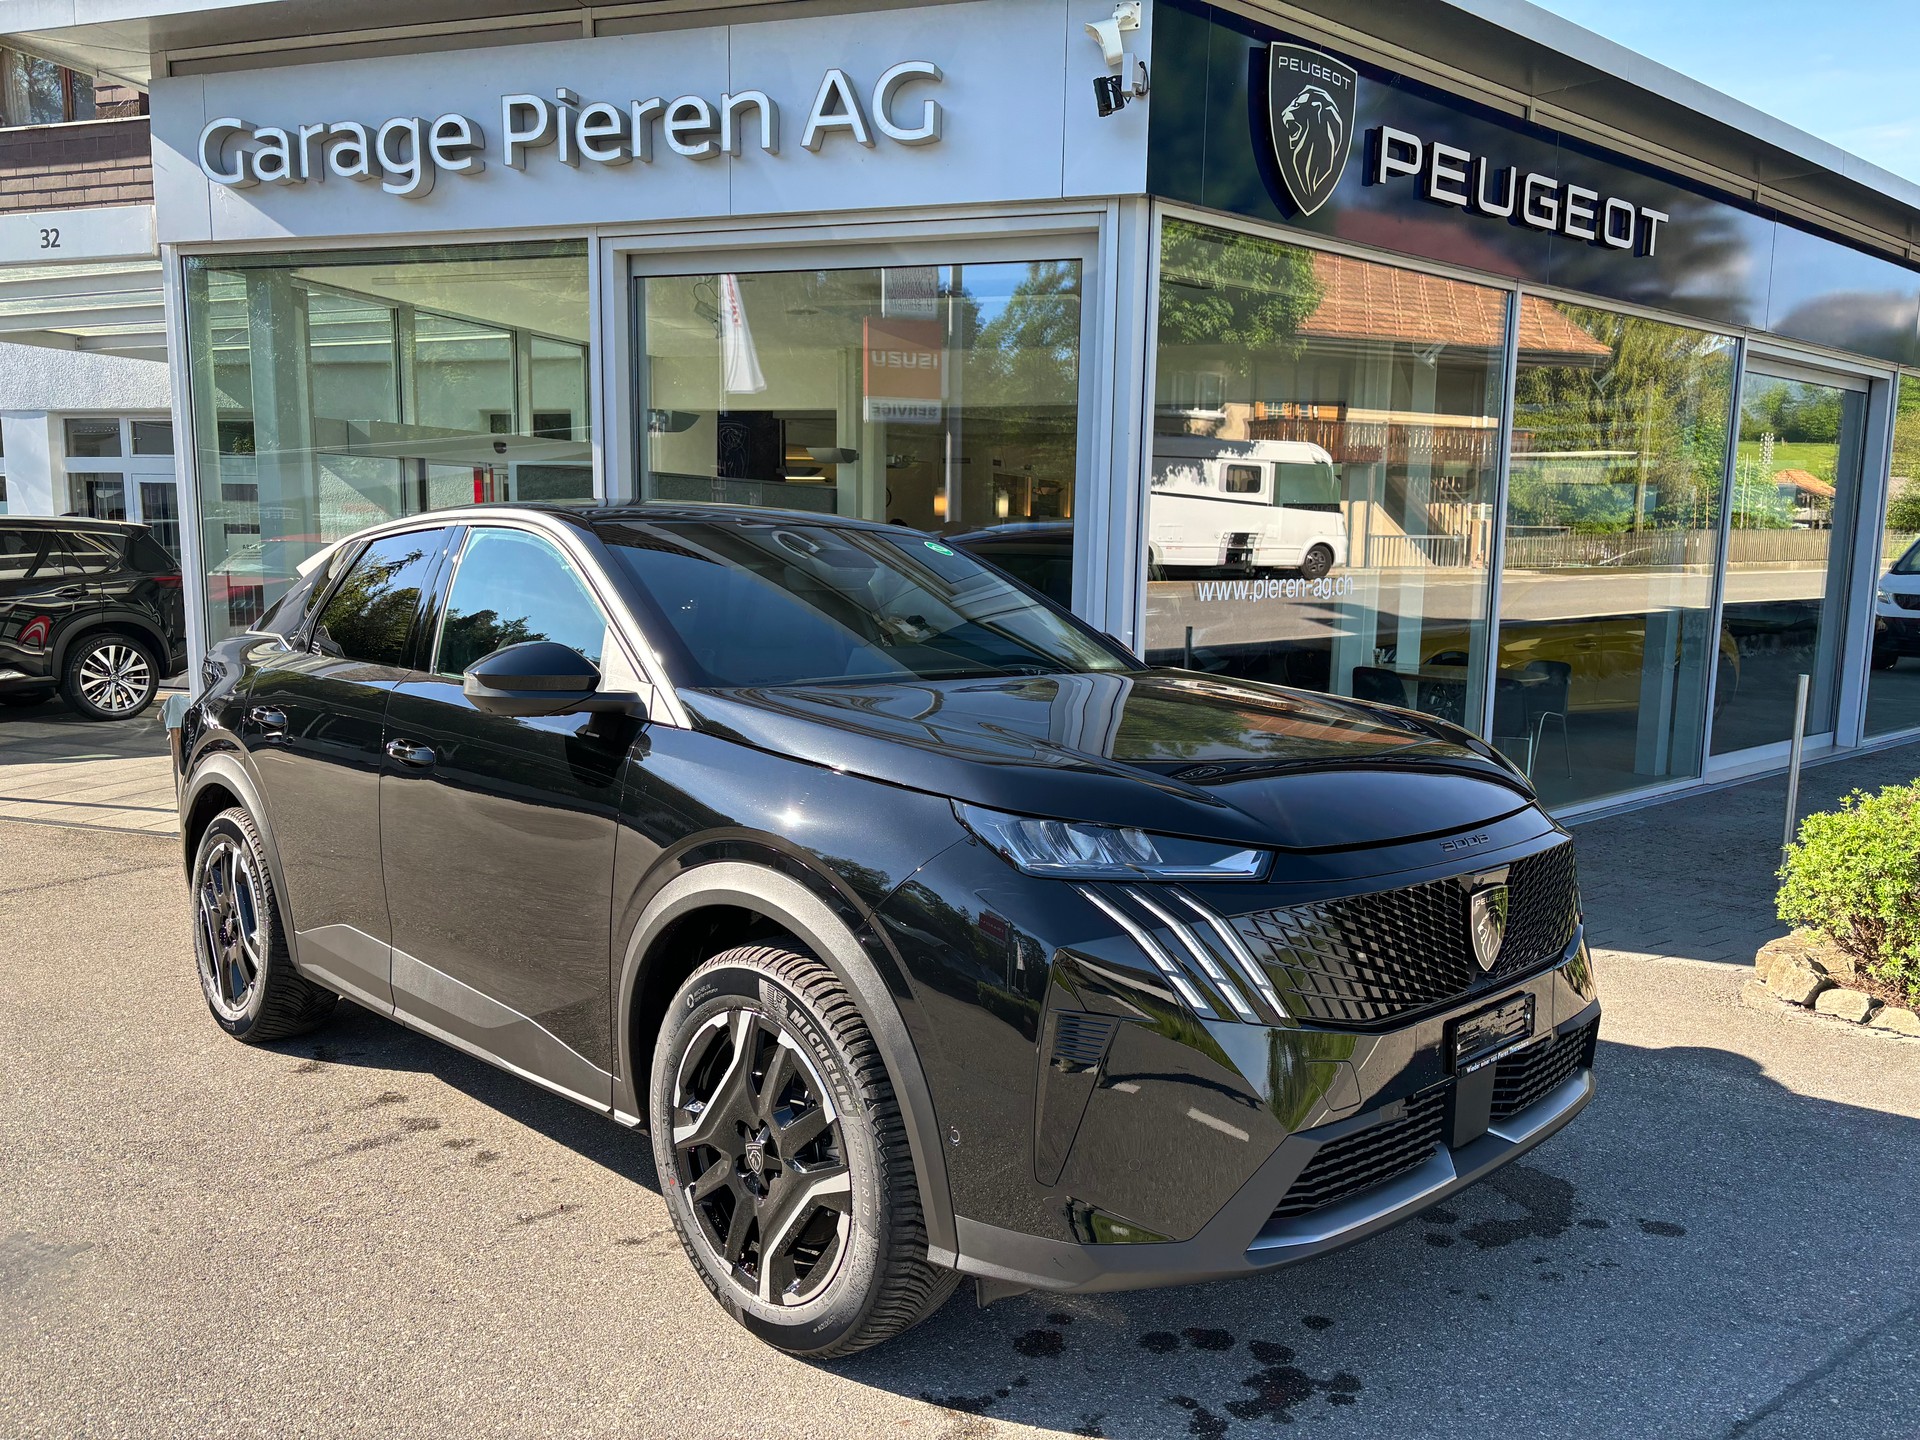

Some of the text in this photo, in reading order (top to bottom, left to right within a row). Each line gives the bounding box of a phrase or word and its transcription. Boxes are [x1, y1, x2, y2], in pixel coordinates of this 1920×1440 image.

[1278, 55, 1351, 90] PEUGEOT
[199, 60, 942, 198] Garage Pieren AG
[1377, 125, 1669, 256] PEUGEOT
[40, 228, 60, 249] 32
[1198, 574, 1353, 602] www.pieren-ag.ch
[1440, 833, 1489, 852] 3008
[1475, 892, 1506, 907] PEUGEOT
[788, 1009, 855, 1111] MICHELIN
